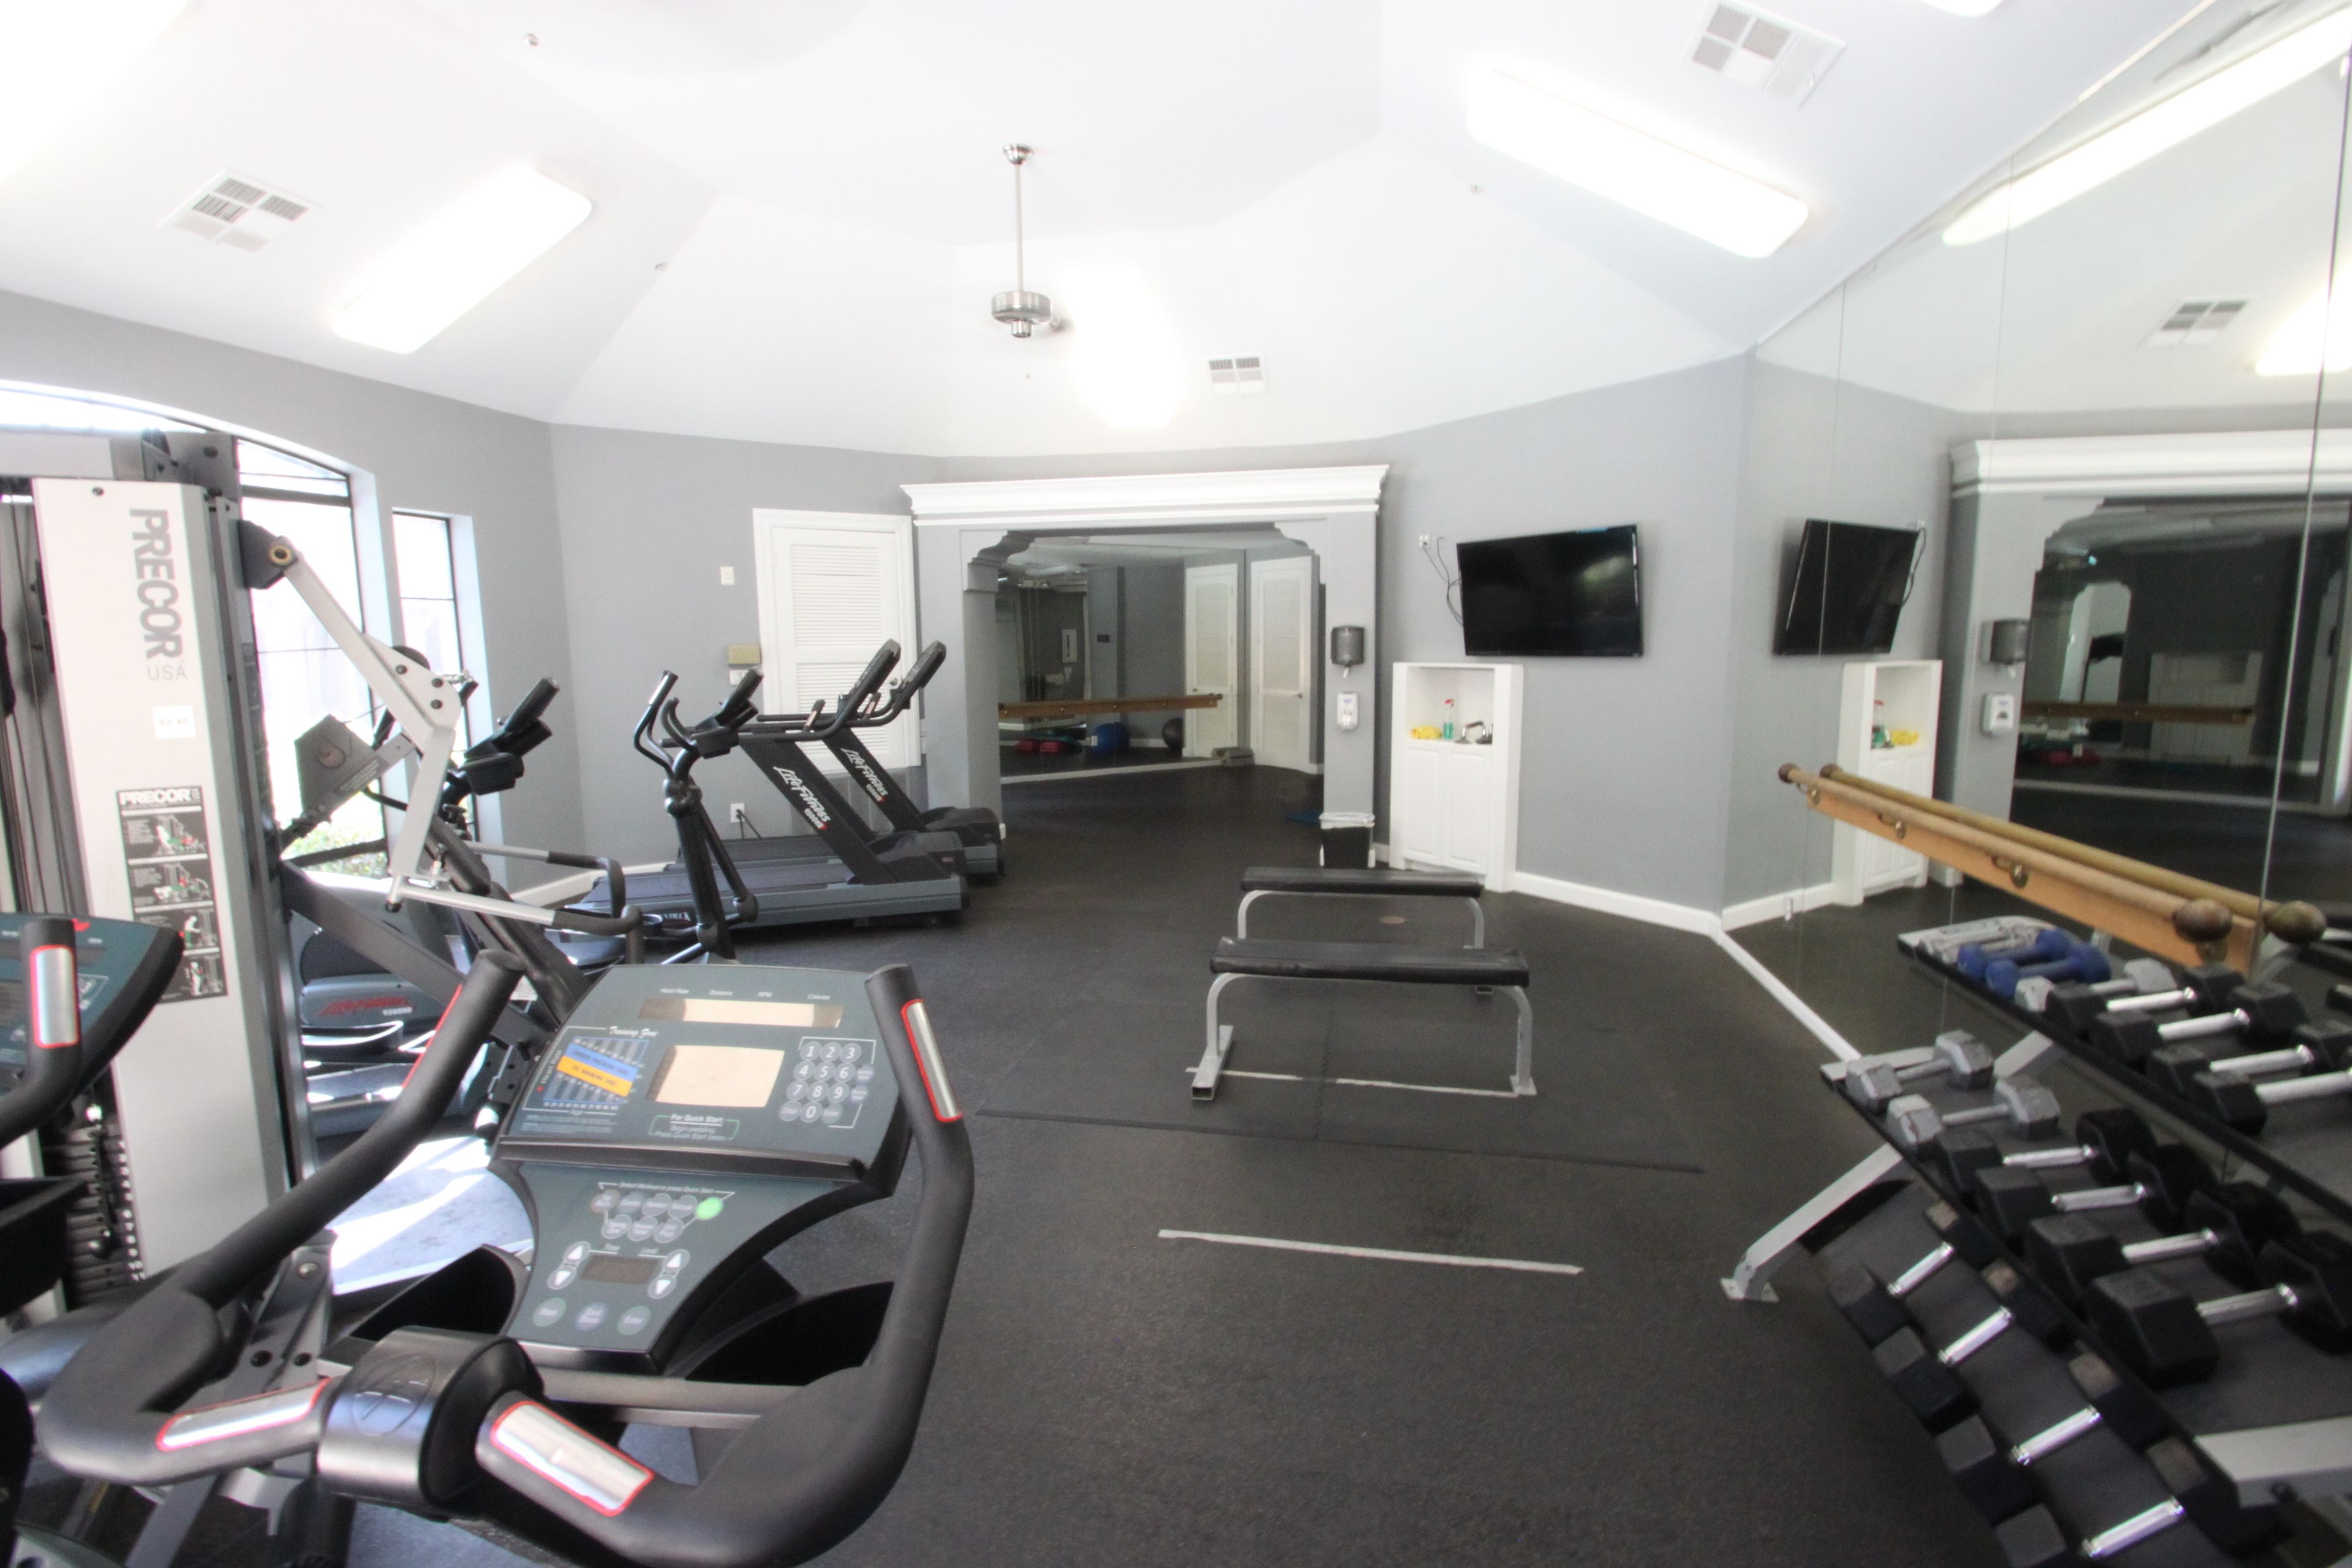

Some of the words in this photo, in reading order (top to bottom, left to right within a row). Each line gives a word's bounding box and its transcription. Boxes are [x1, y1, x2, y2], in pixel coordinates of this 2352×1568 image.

[129, 508, 183, 660] PRECOR
[147, 664, 188, 681] USA
[855, 764, 889, 796] Fitness
[119, 788, 192, 805] PRECOR
[791, 785, 831, 822] Fitness
[805, 1046, 815, 1057] 1
[826, 1046, 835, 1058] 2
[846, 1047, 856, 1059] 3
[799, 1065, 809, 1076] 4
[819, 1066, 829, 1077] 5
[840, 1067, 850, 1079] 6
[793, 1085, 803, 1096] 7
[812, 1085, 823, 1098] 8
[834, 1087, 843, 1098] 9
[805, 1106, 816, 1118] 0
